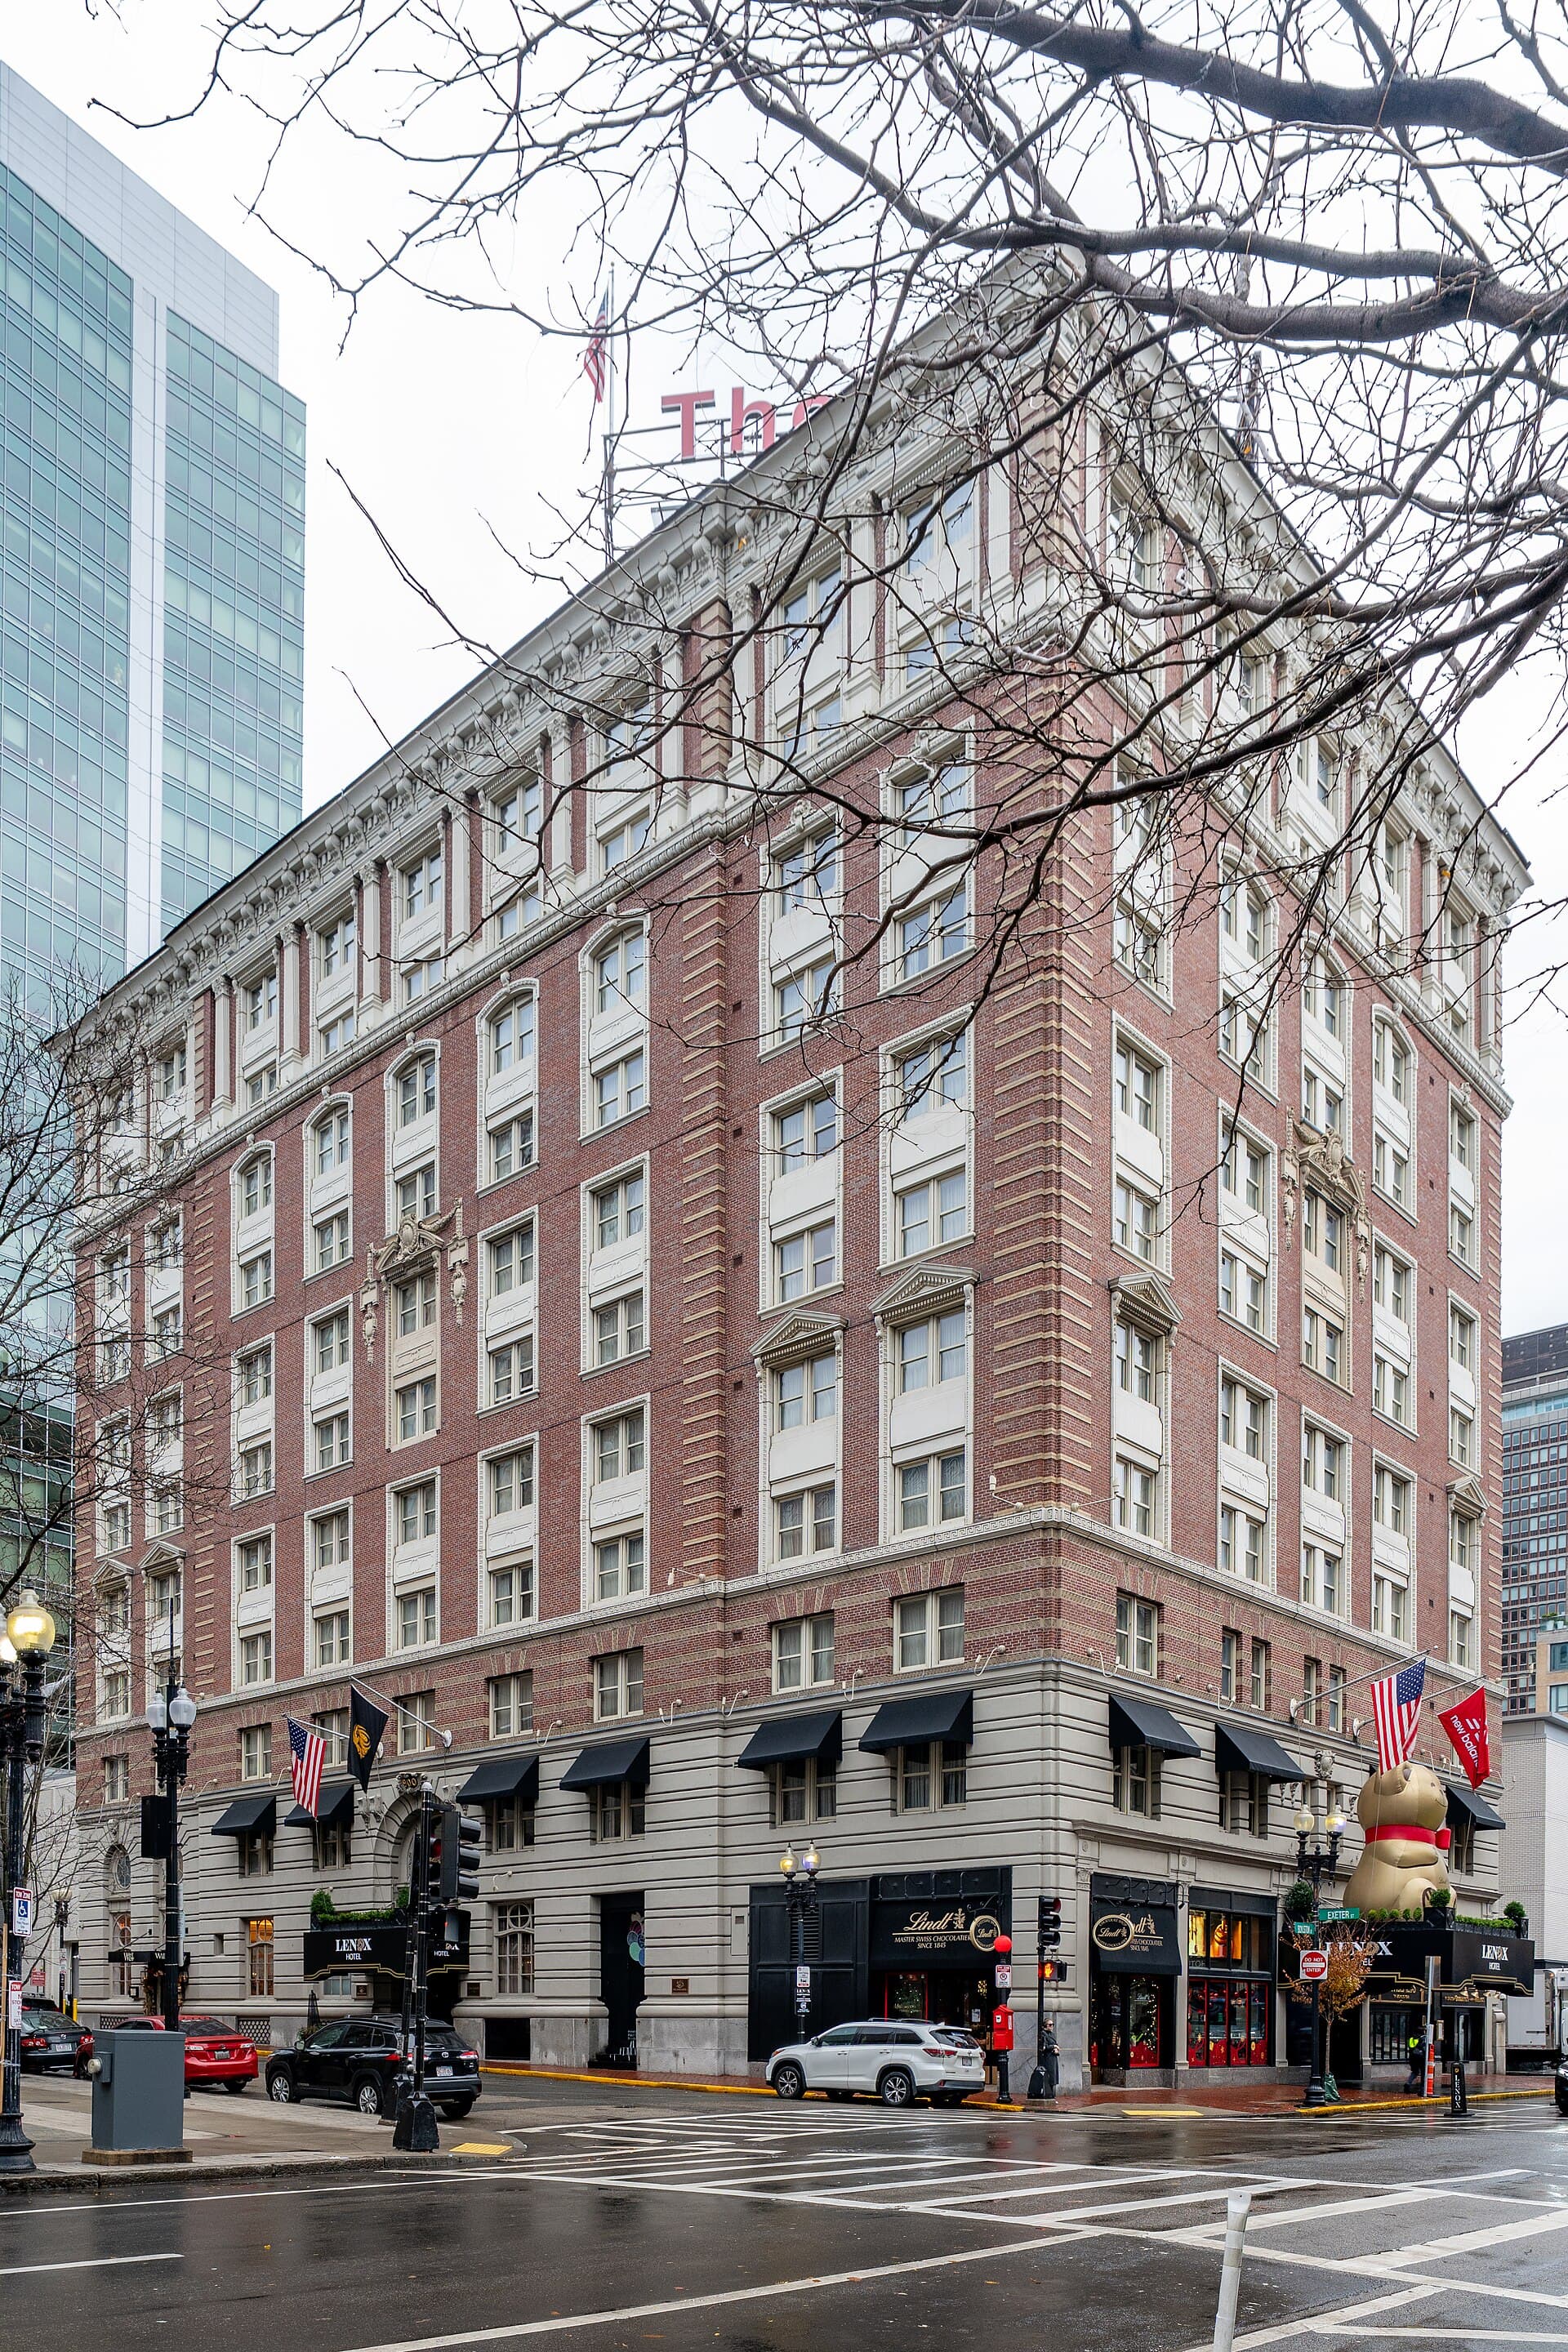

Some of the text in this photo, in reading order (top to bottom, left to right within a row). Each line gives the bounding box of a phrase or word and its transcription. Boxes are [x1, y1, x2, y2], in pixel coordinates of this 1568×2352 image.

[1450, 1715, 1466, 1734] new
[903, 1911, 954, 1931] Lindt
[1327, 1911, 1349, 1919] EXETER
[1098, 1927, 1121, 1937] Lindt
[335, 1938, 372, 1952] LENOX
[1481, 1944, 1508, 1961] LENOX
[1489, 1962, 1501, 1970] HOTEL
